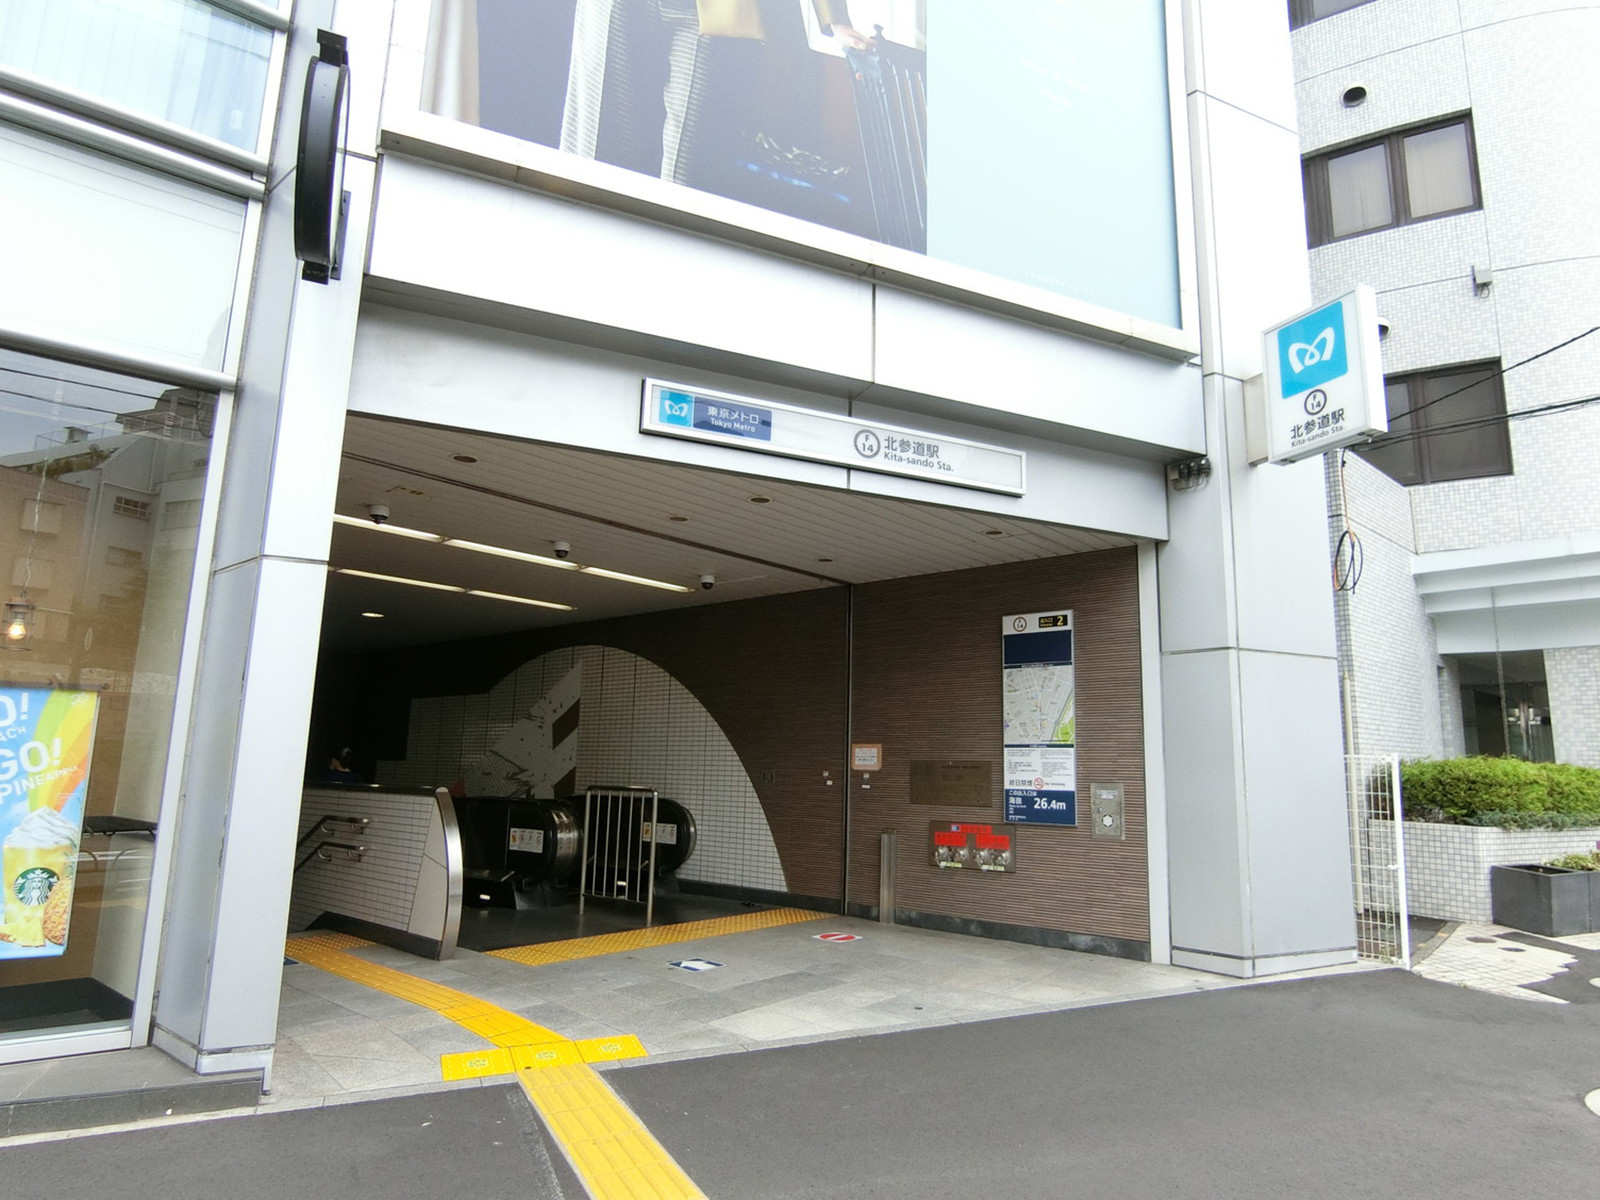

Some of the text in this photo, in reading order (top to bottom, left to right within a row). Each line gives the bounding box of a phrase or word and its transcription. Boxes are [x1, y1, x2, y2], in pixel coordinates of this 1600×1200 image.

[707, 405, 759, 425] 東京メトロ
[1290, 408, 1345, 439] 北参道駅
[710, 418, 756, 433] Tokyo Metro
[865, 434, 870, 442] F
[1291, 430, 1330, 447] Kita-sando
[862, 443, 874, 453] 14
[883, 435, 940, 459] 北参道駅
[883, 451, 955, 472] Kita-sando Sta.
[1056, 615, 1064, 626] 2
[0, 737, 62, 781] GO!
[1033, 797, 1067, 810] 26.4m
